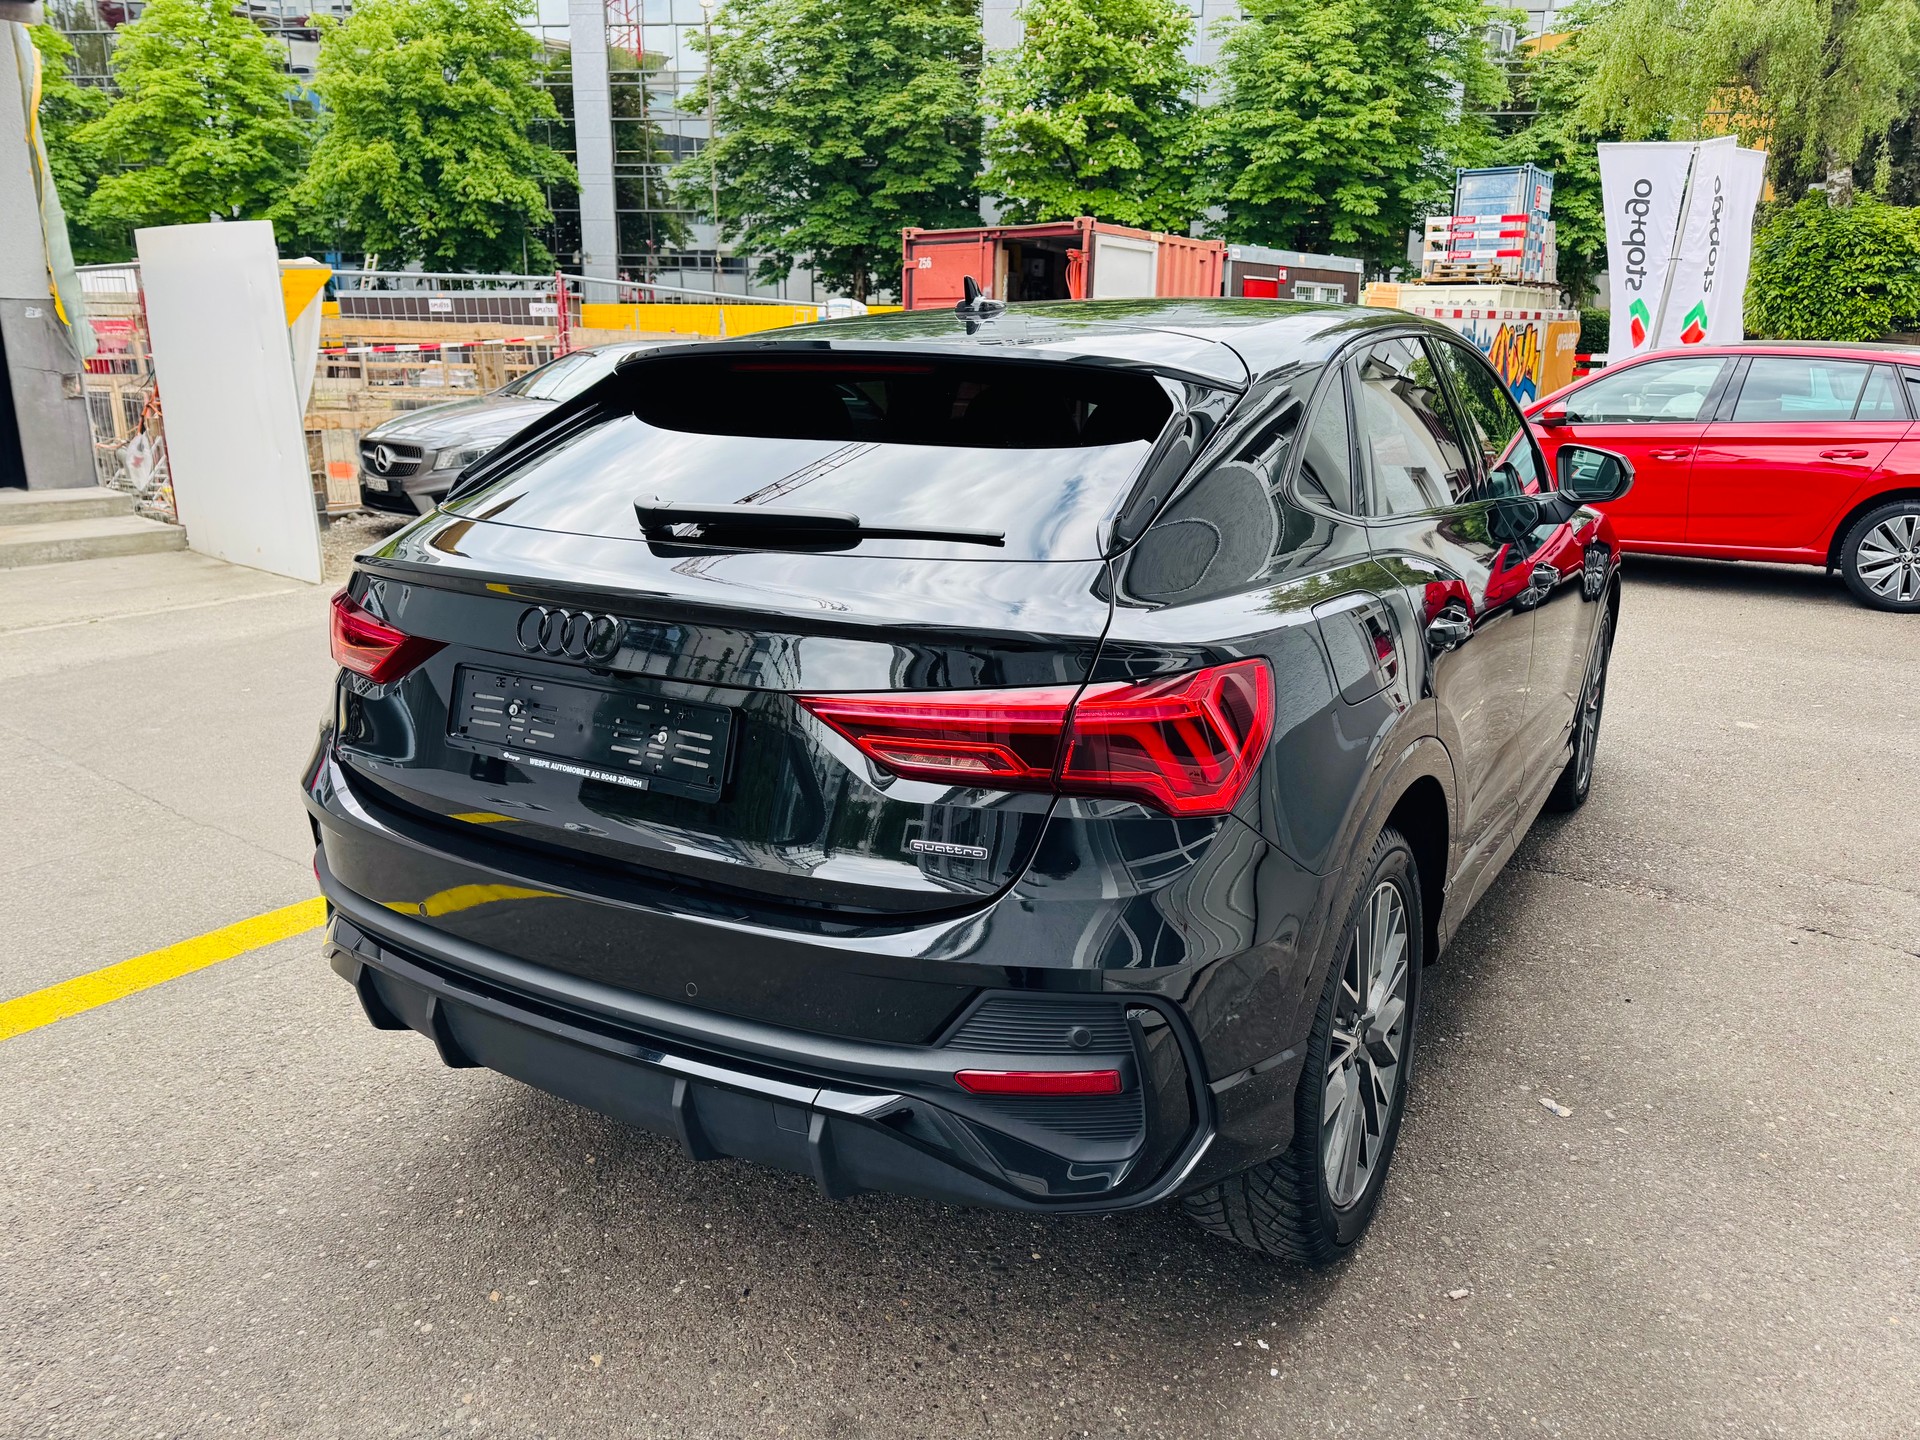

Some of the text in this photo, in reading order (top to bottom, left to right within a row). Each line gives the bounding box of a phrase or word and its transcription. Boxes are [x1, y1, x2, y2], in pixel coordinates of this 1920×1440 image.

[529, 757, 550, 769] WESPE
[551, 762, 590, 777] AUTOMOBILE
[601, 772, 617, 782] 8048
[617, 775, 643, 788] ZÜRICH
[914, 842, 983, 856] quattro
